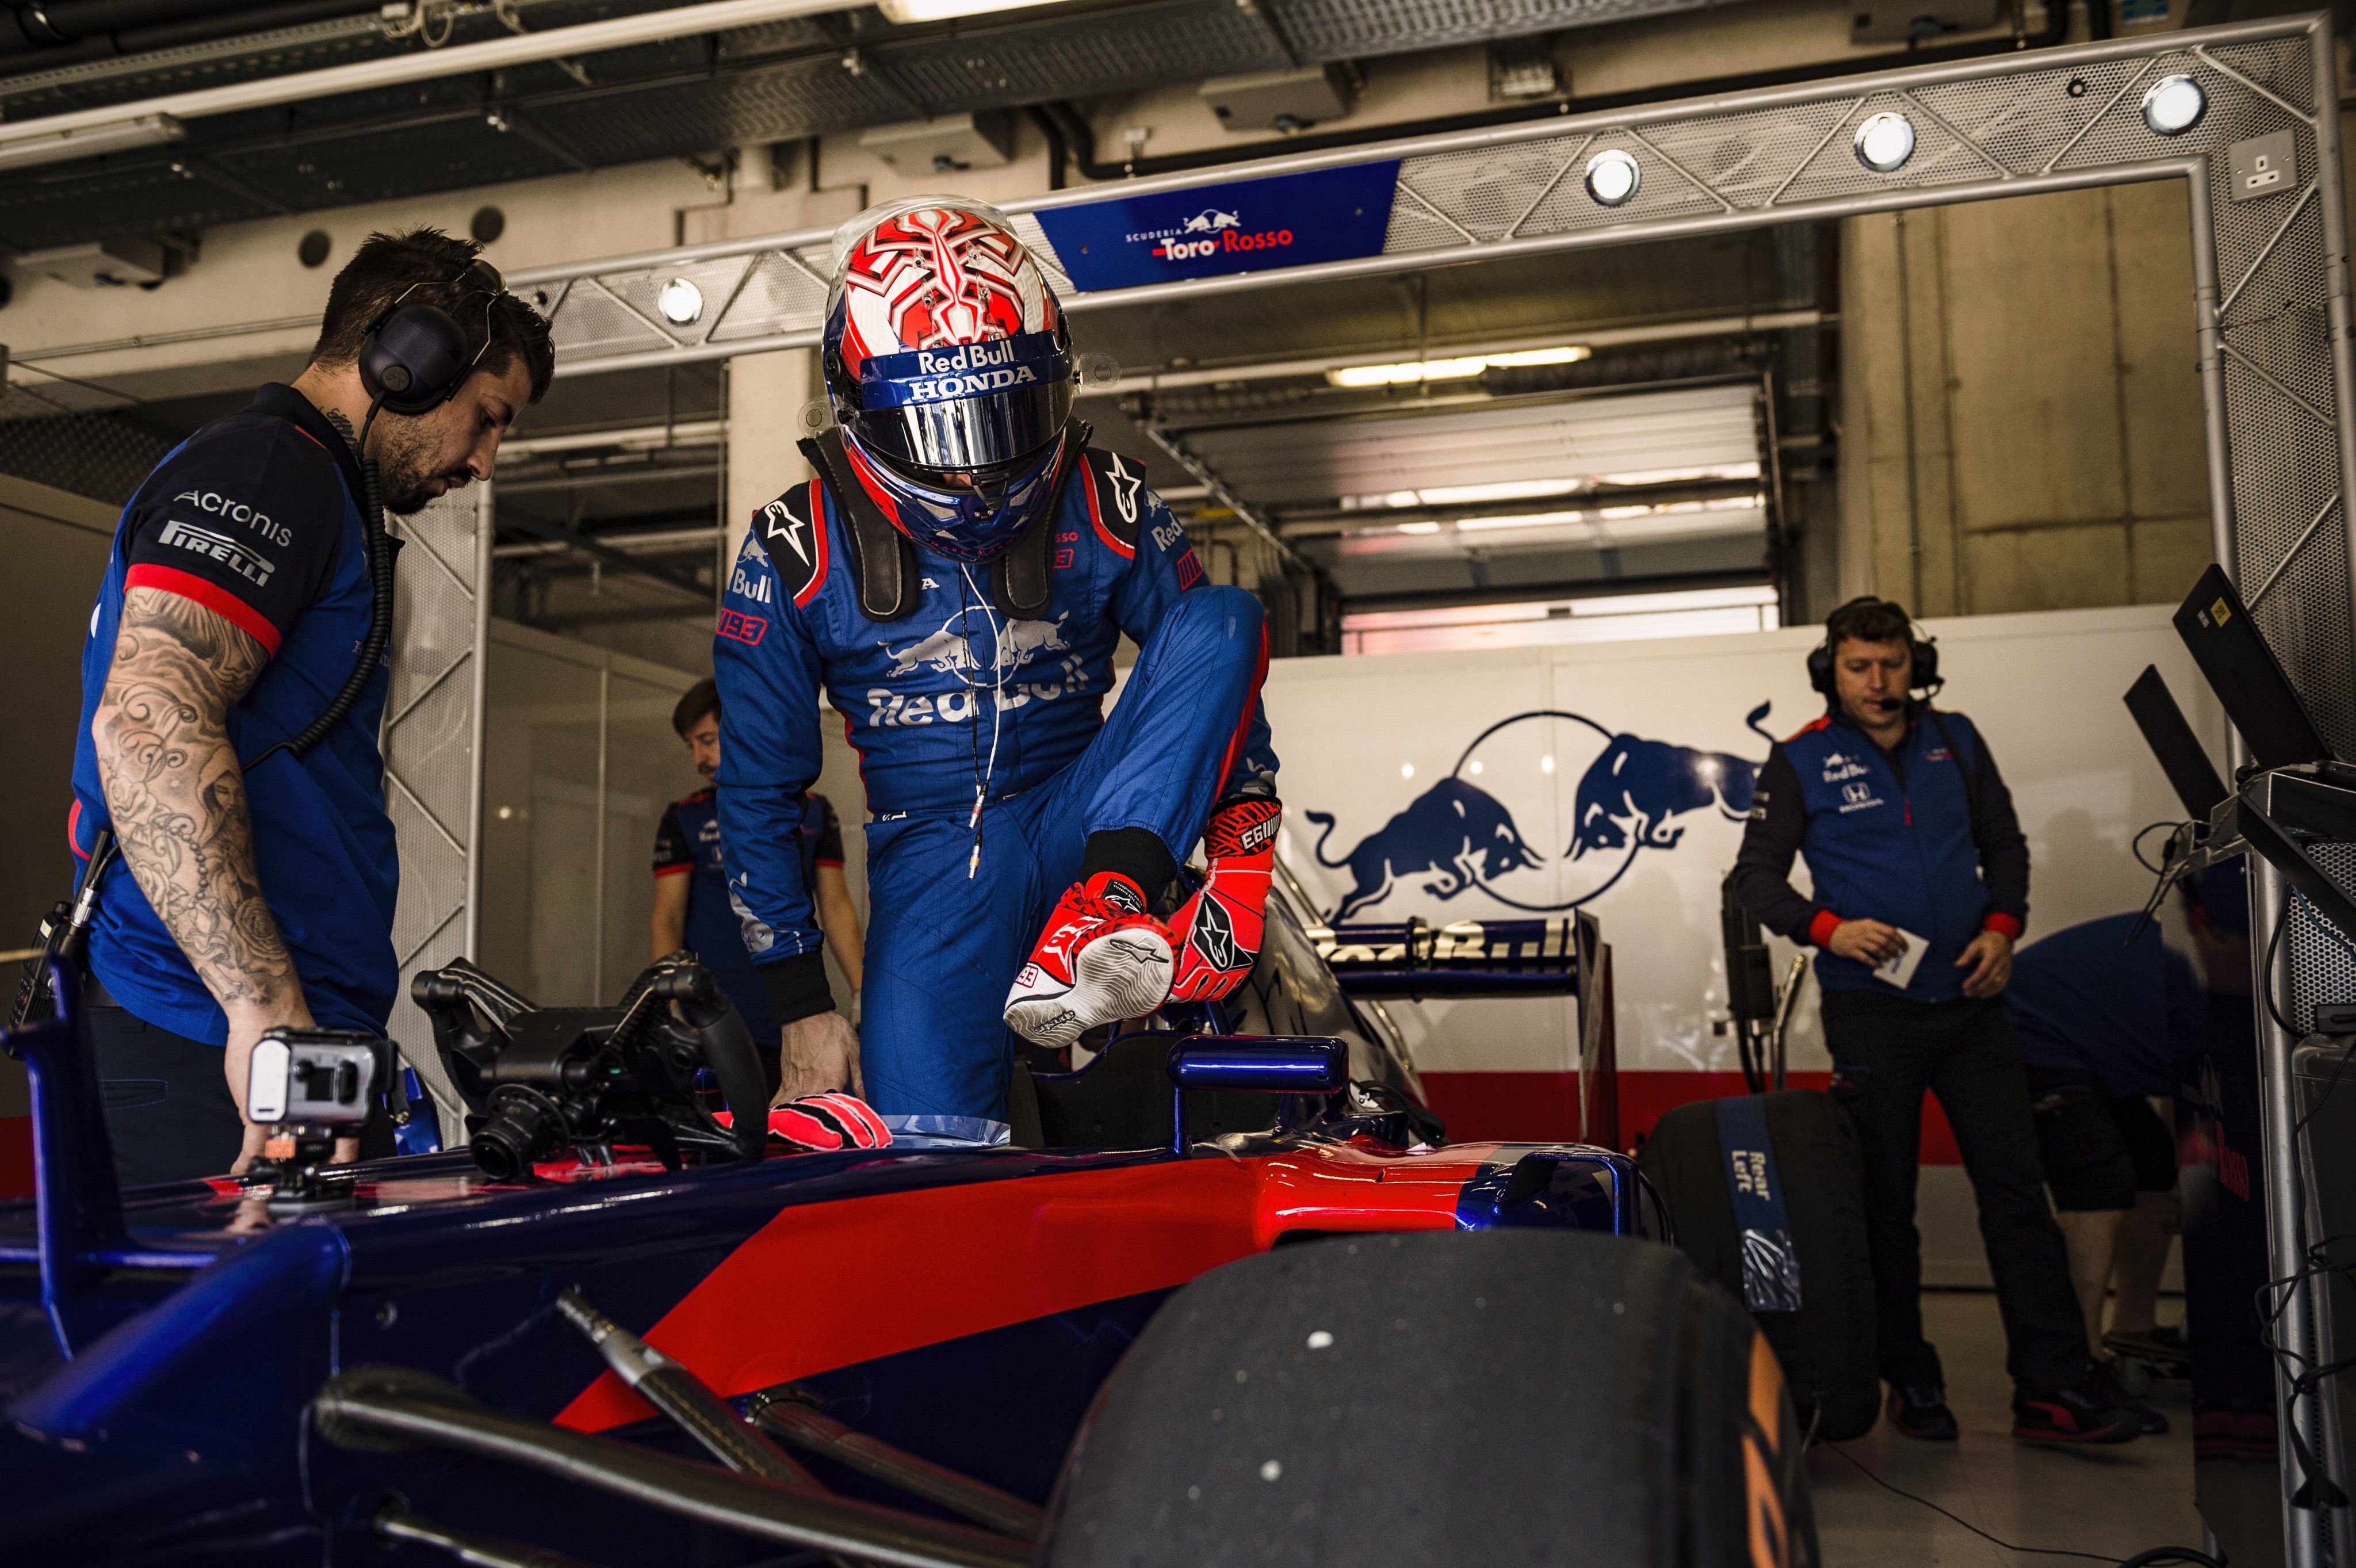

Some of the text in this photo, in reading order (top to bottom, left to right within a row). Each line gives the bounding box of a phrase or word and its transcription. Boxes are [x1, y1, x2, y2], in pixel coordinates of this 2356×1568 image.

[1125, 228, 1183, 243] SCUDERIA
[1161, 230, 1294, 261] Toro Rosso
[918, 340, 1015, 374] Red Bull
[909, 366, 1037, 401] HONDA
[1151, 511, 1183, 552] Red
[158, 520, 275, 587] PIRELLI
[732, 568, 771, 603] Bull
[1731, 1149, 1753, 1194] Left
[1749, 1151, 1772, 1202] Rear
